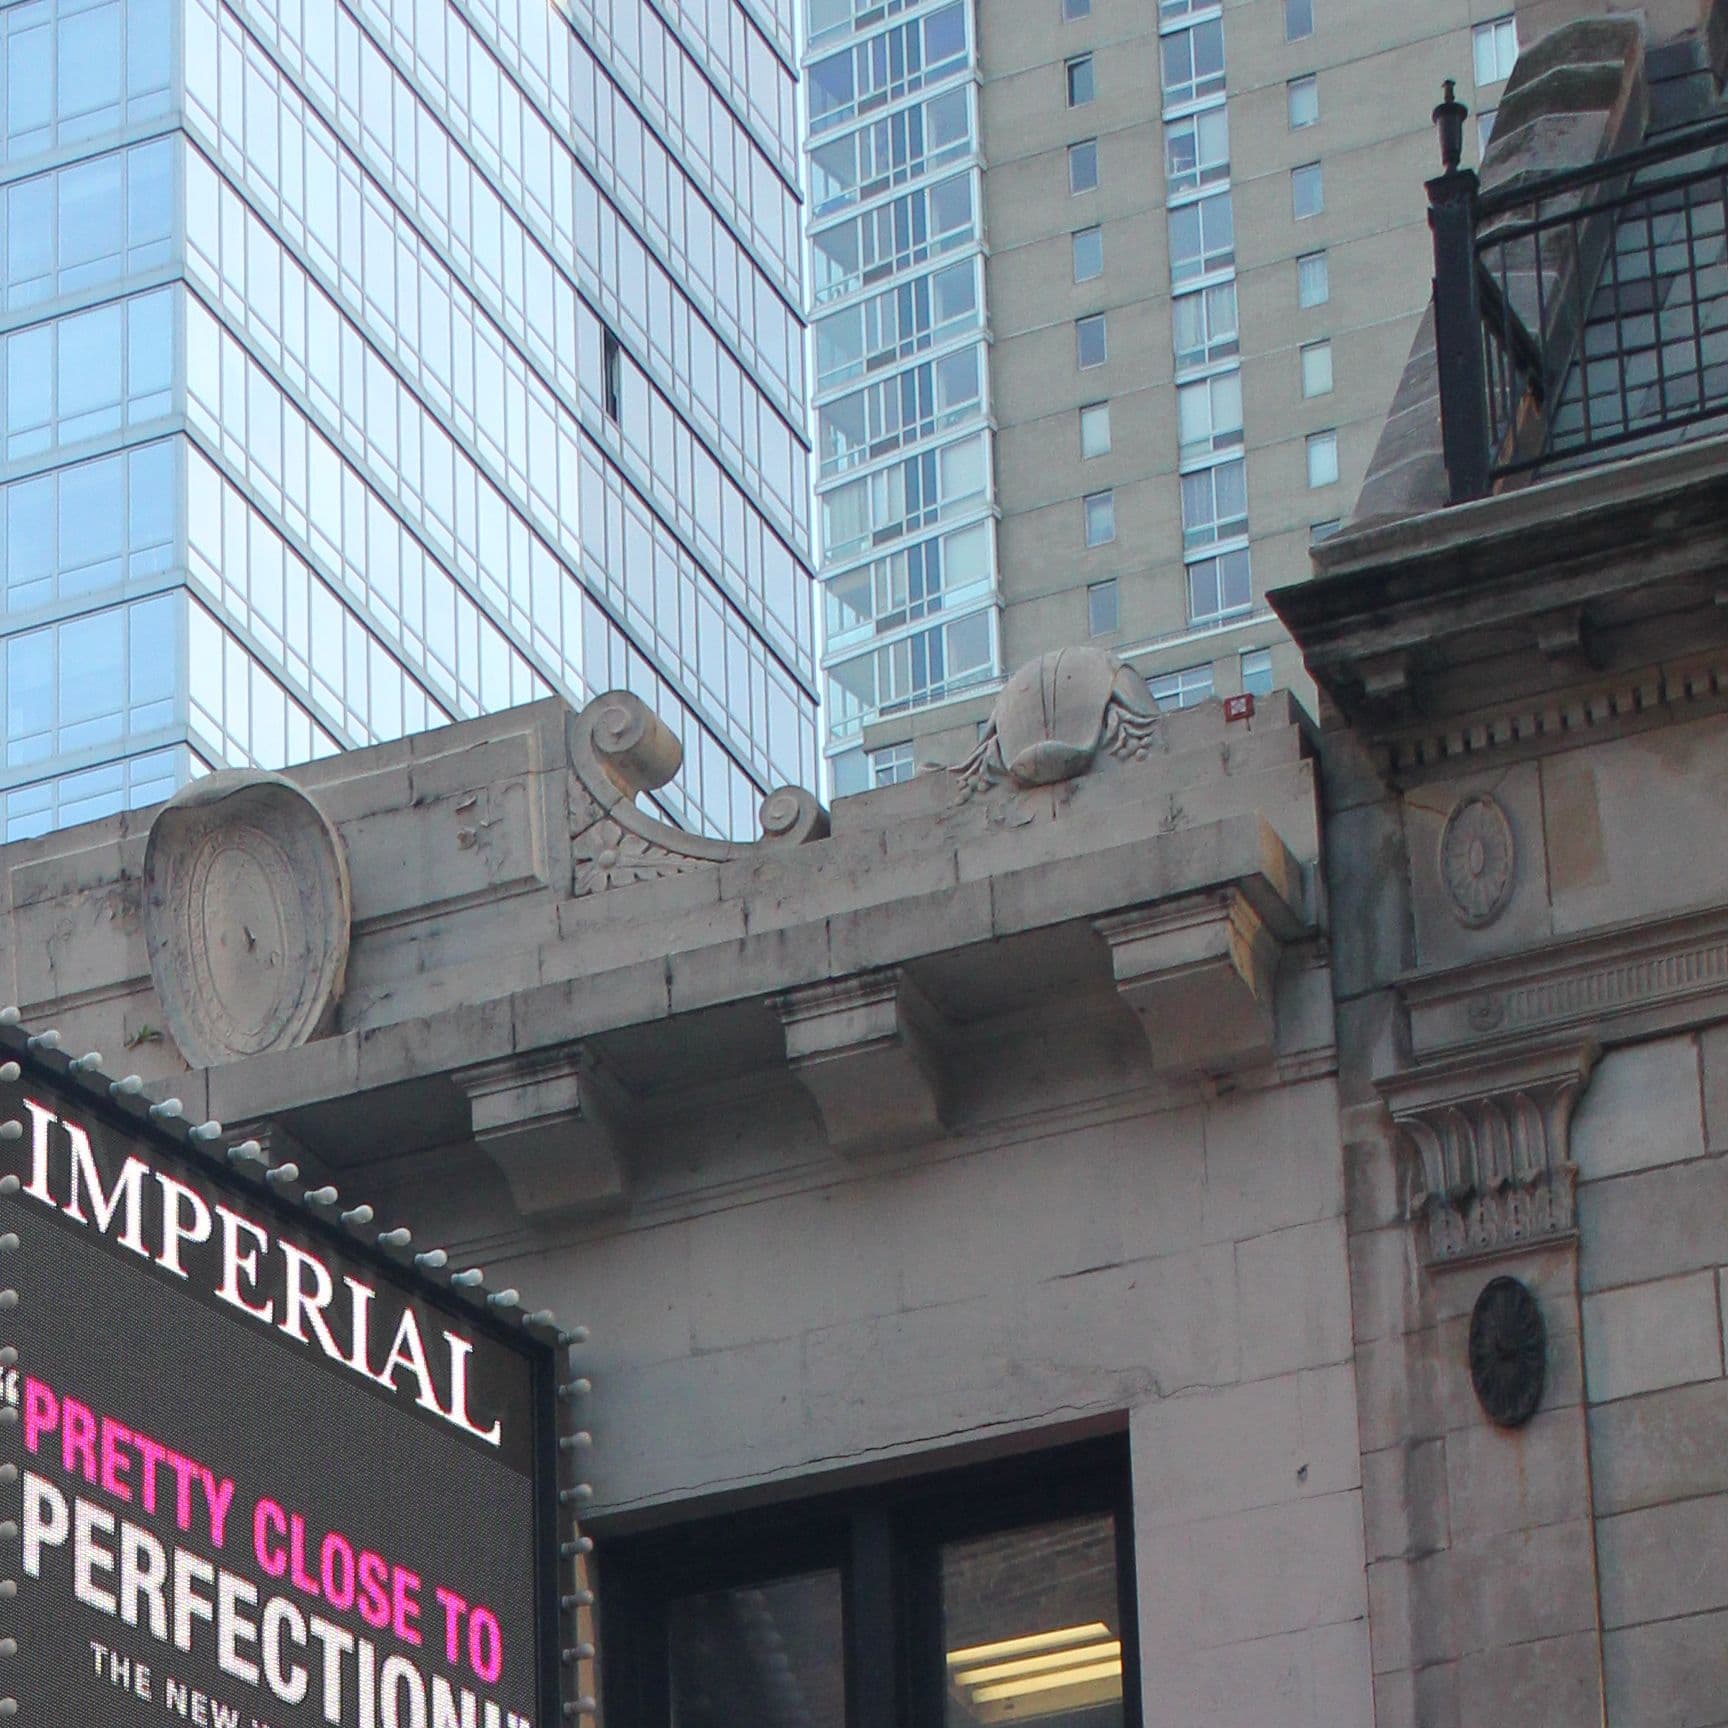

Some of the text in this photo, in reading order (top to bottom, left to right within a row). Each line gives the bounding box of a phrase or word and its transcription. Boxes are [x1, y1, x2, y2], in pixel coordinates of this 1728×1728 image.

[22, 1097, 501, 1448] IMPERIAL
[90, 1640, 153, 1701] THE
[253, 1496, 422, 1647] CLOSE
[437, 1586, 503, 1684] TO
